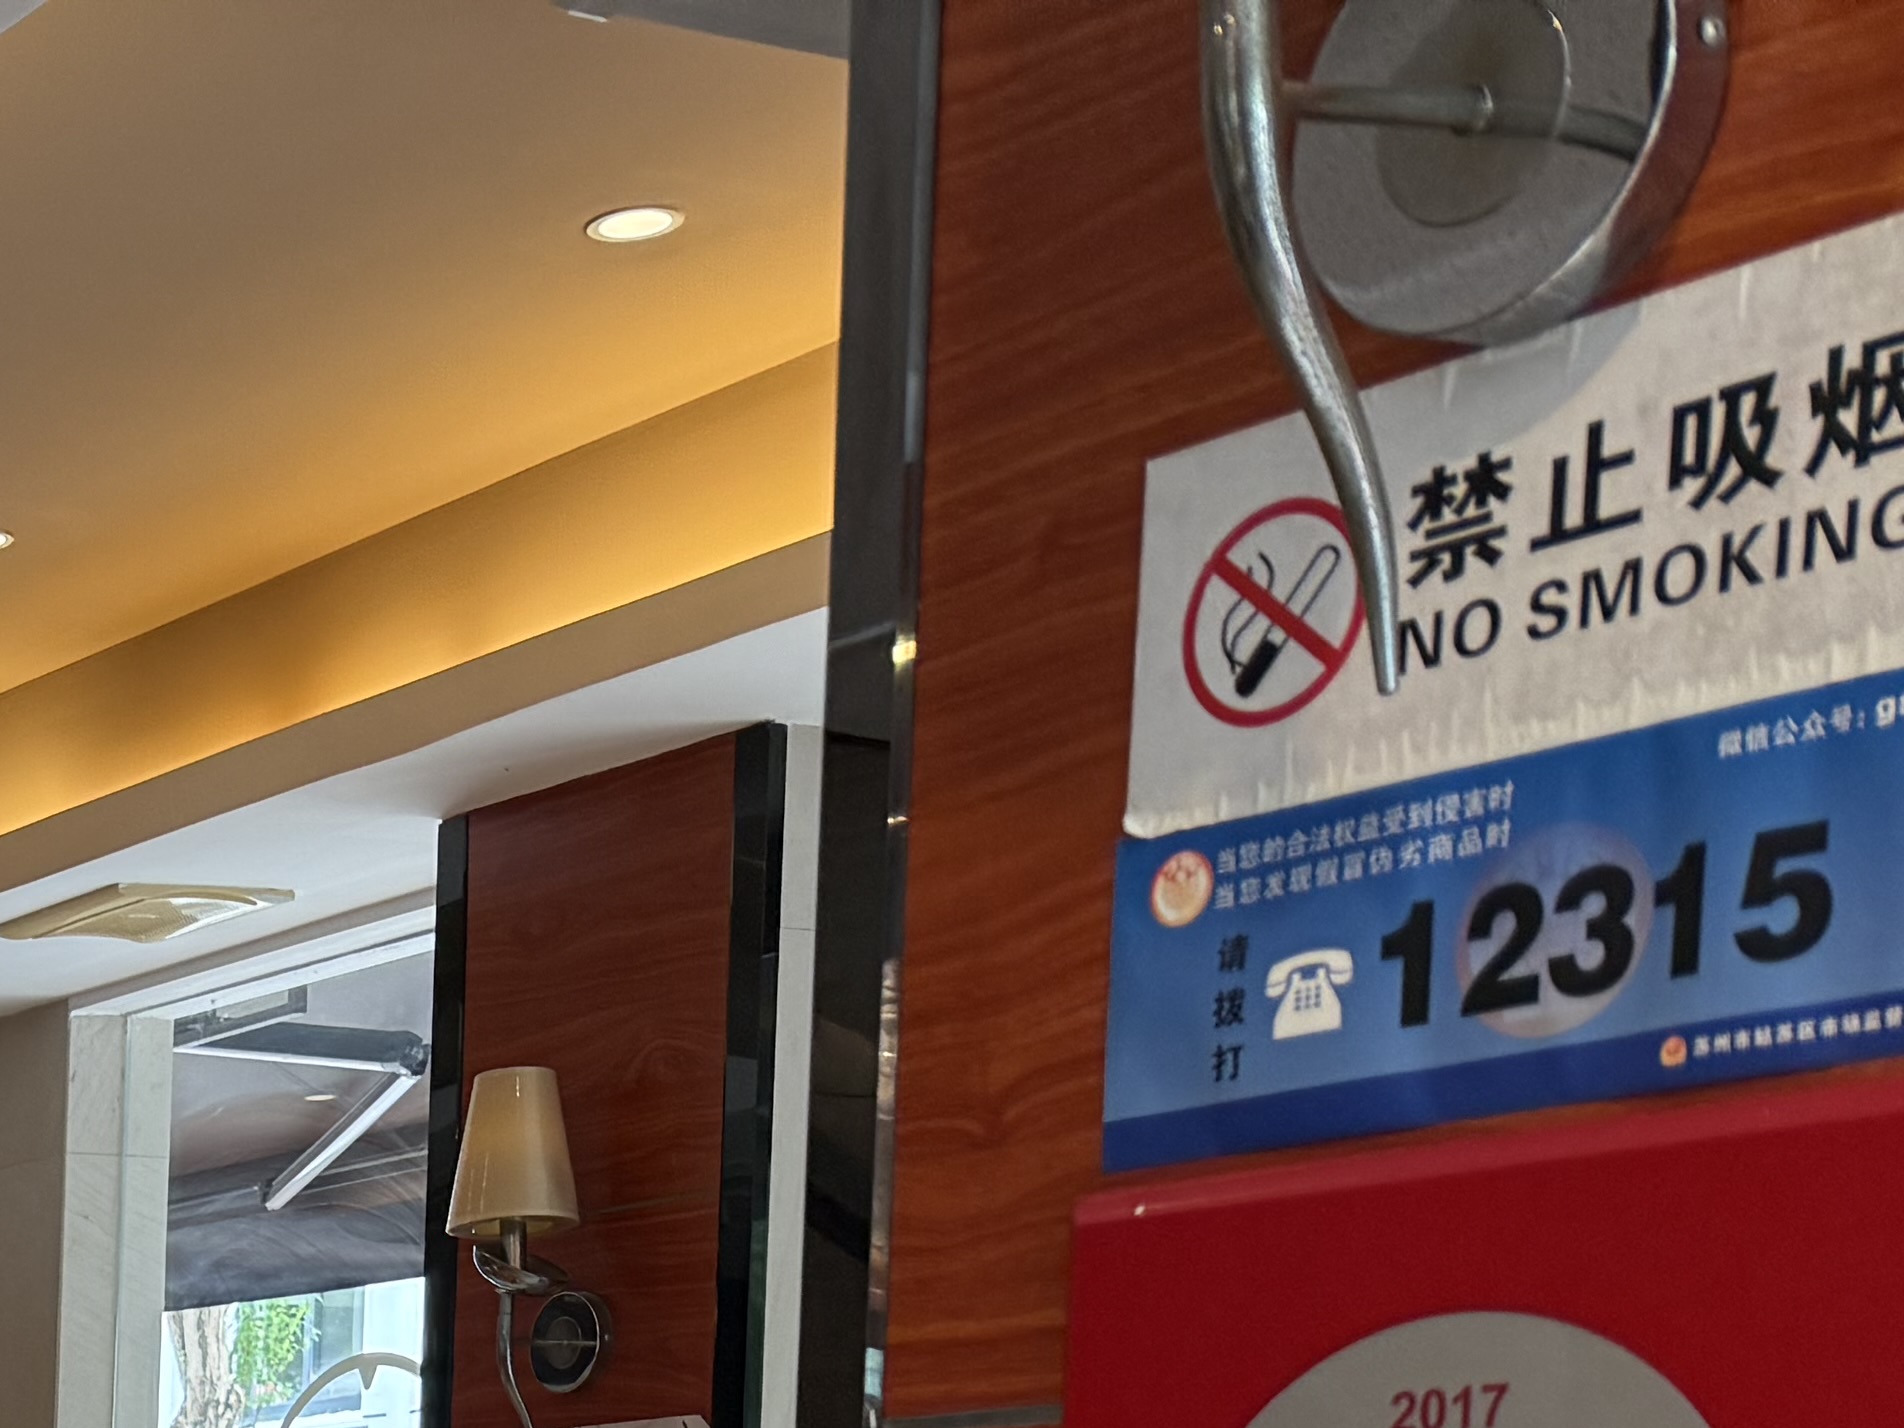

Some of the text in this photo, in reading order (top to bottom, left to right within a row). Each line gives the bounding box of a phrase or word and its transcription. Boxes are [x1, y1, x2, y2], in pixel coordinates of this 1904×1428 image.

[1405, 331, 1904, 588] 禁止吸烟
[1398, 483, 1904, 676] NO SMOKING
[1212, 934, 1249, 1082] 请拨打
[1380, 819, 1834, 1029] 12315
